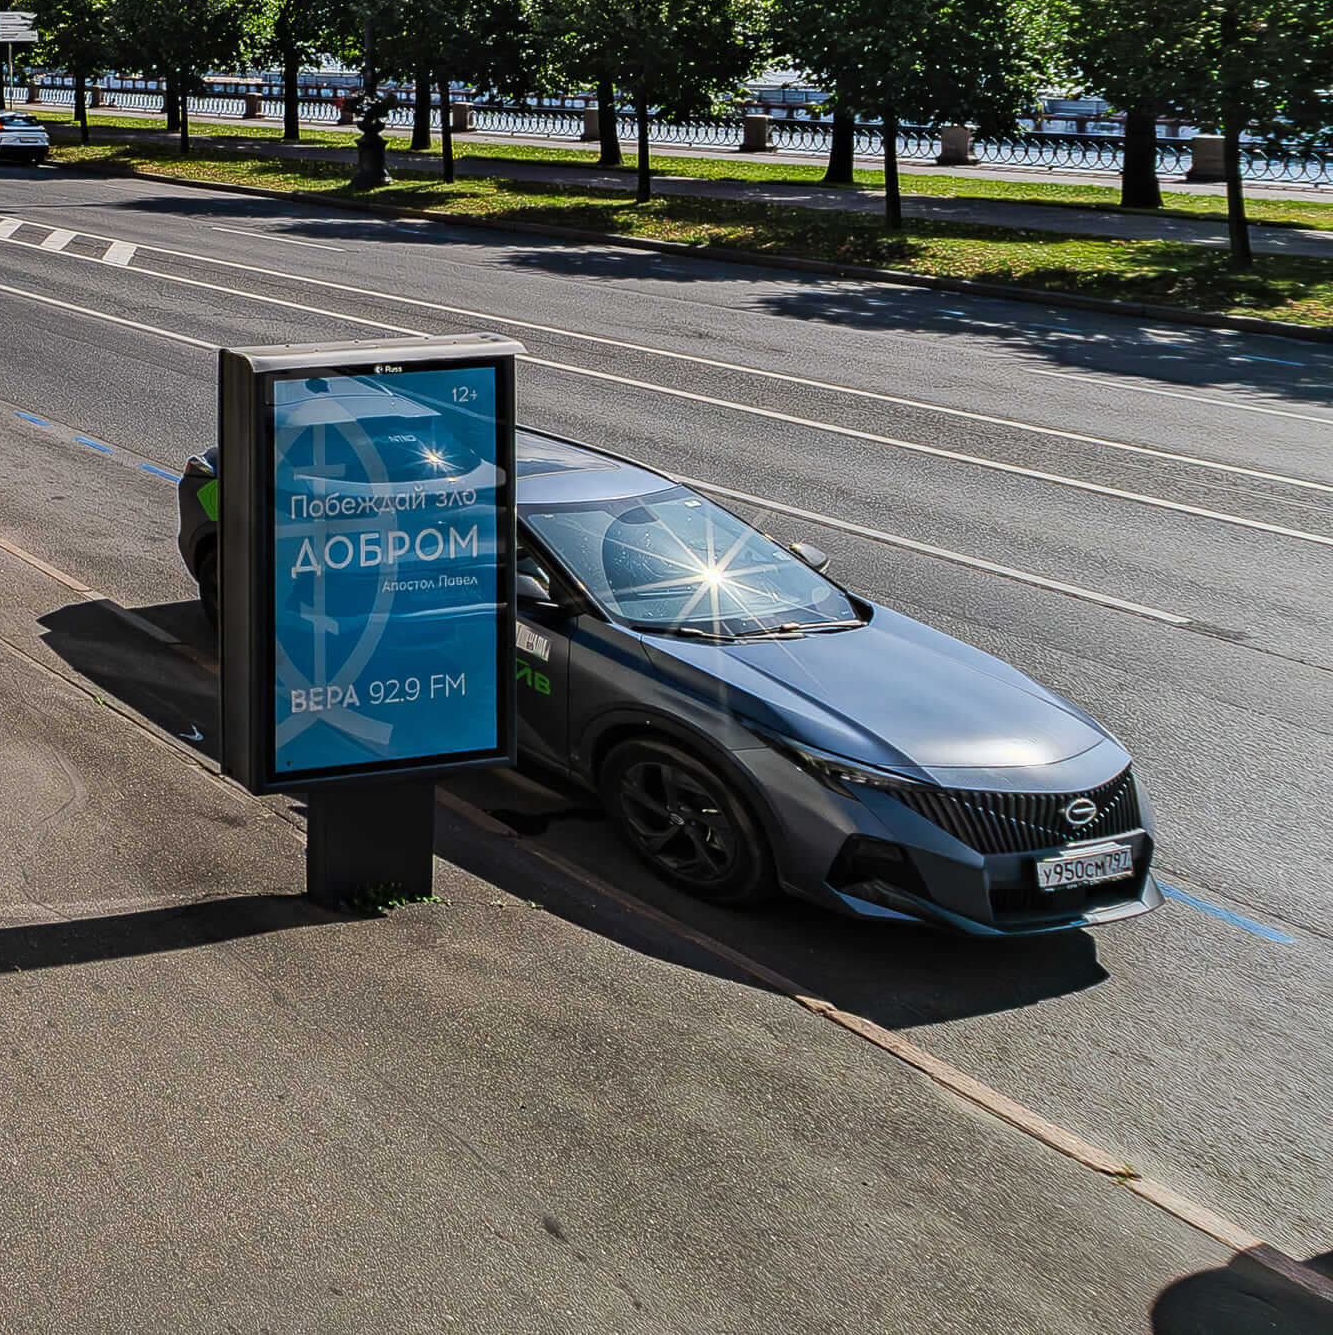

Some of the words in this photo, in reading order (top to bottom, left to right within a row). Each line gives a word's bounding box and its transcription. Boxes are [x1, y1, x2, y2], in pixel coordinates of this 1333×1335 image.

[452, 386, 478, 402] 12+
[291, 484, 426, 519] Побеждай
[436, 488, 477, 507] зло
[291, 524, 478, 579] ДОБРОМ
[382, 579, 435, 593] Апостол
[439, 574, 478, 588] Павел
[291, 684, 361, 714] ВЕРА
[369, 677, 420, 705] 92.9
[430, 673, 466, 699] FM
